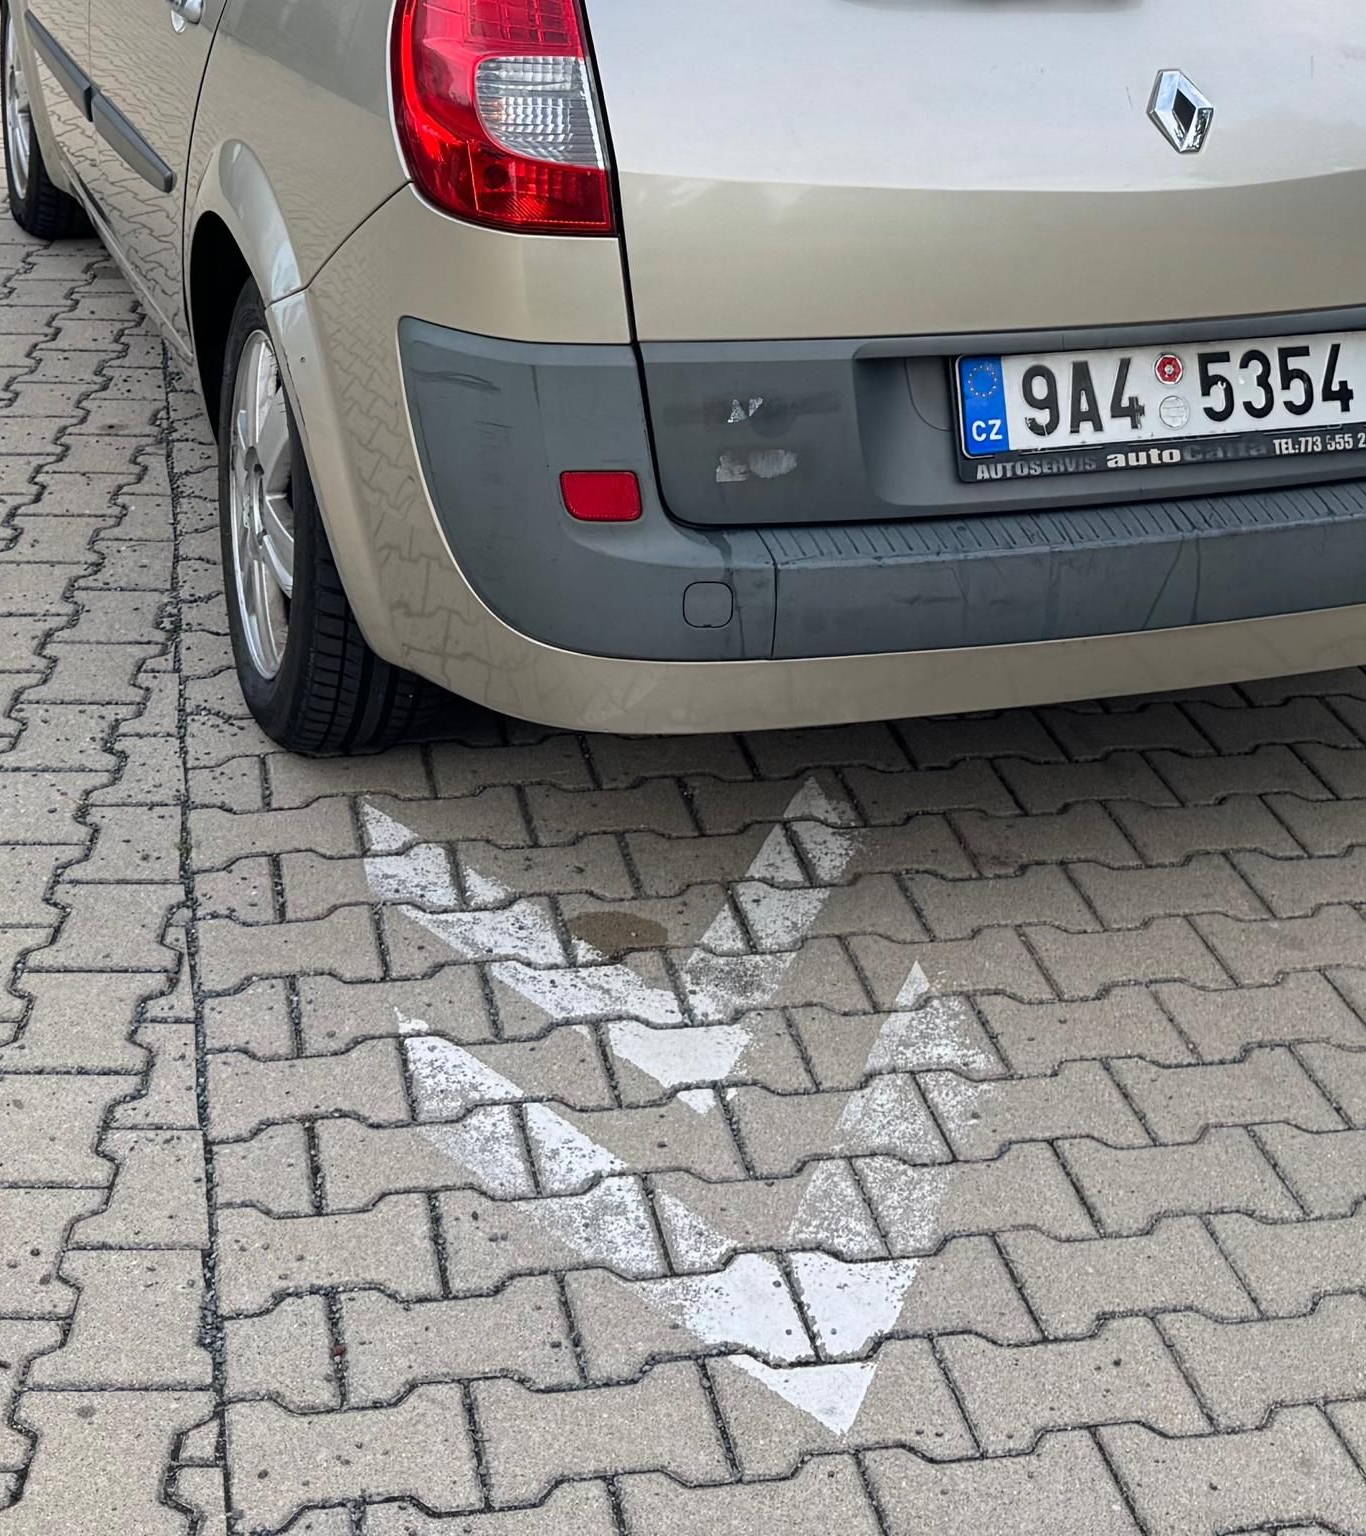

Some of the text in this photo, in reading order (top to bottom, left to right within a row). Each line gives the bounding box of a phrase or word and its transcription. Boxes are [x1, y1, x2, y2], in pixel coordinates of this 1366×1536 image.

[1021, 343, 1354, 437] 9A4 5354
[971, 419, 1003, 442] CZ
[976, 455, 1096, 481] AUTOSERVIS
[1325, 433, 1354, 452] 555
